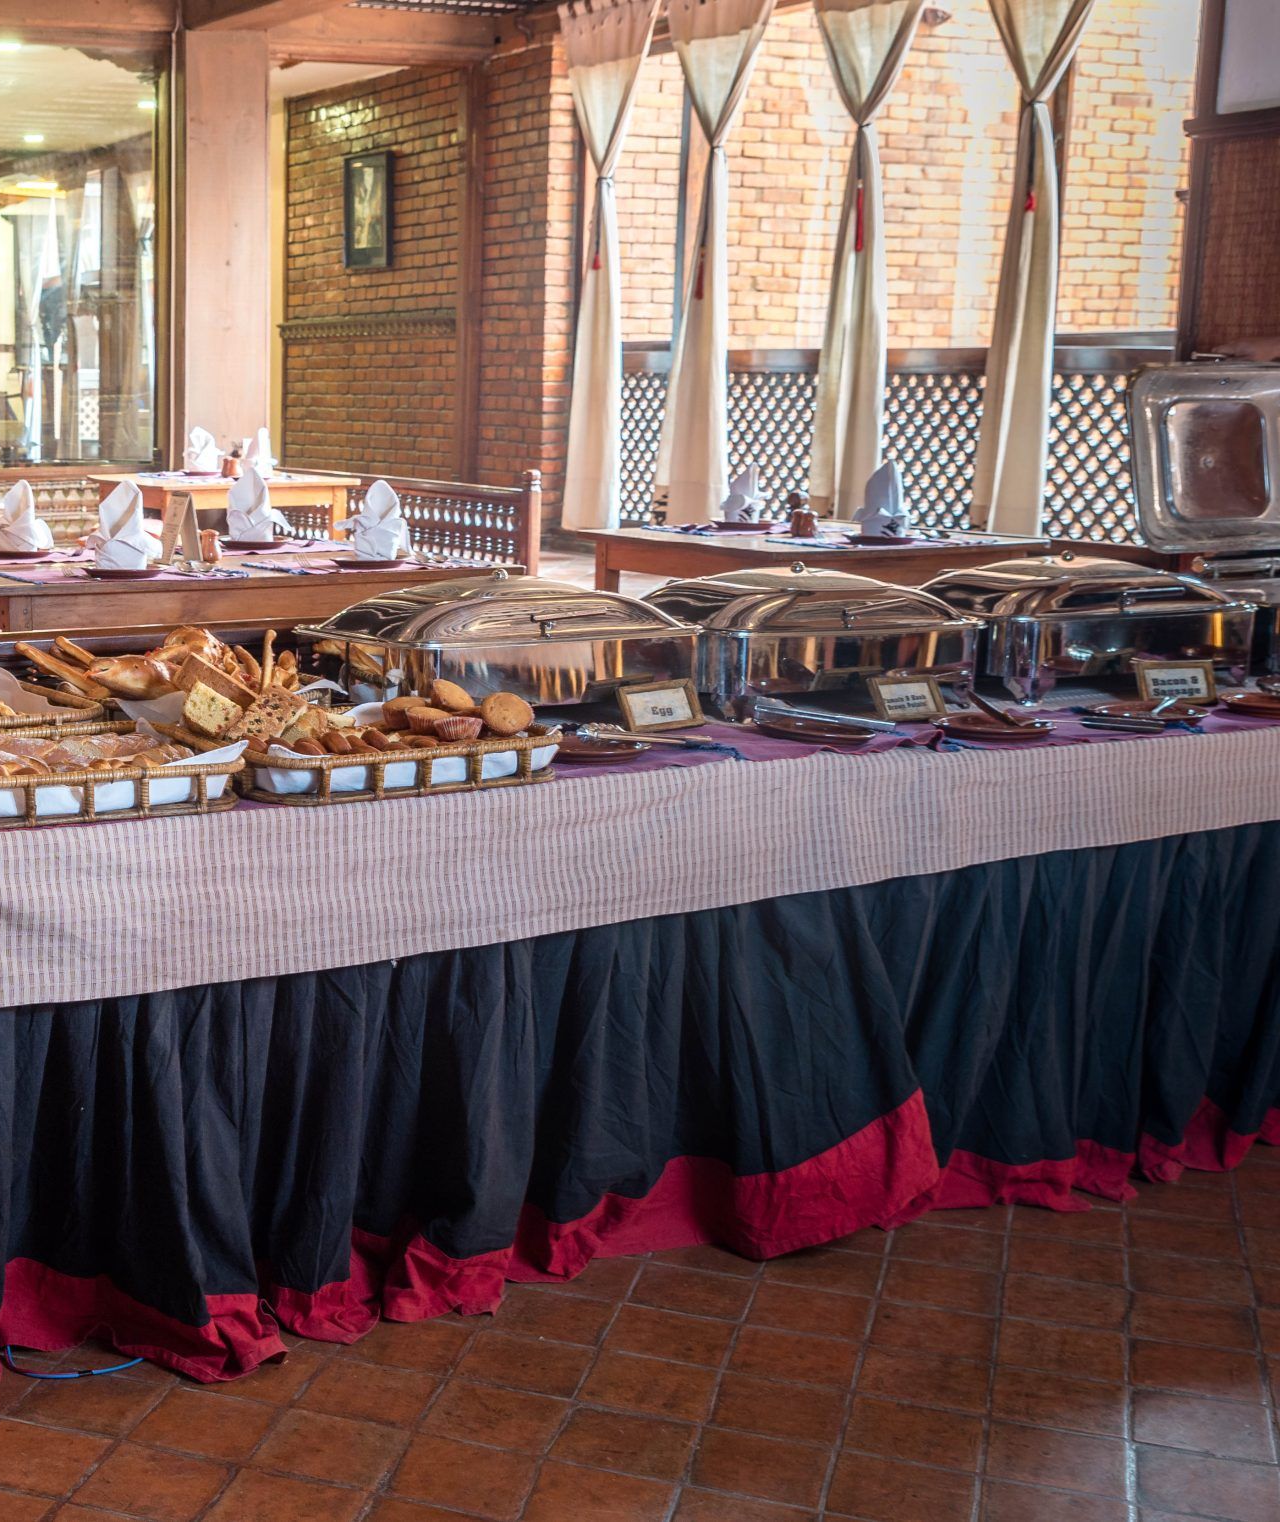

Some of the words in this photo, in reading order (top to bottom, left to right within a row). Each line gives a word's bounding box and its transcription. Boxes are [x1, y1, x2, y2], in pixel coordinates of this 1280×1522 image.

[1151, 678, 1187, 687] Bacon
[1152, 688, 1201, 697] Sausage
[651, 706, 673, 717] Egg
